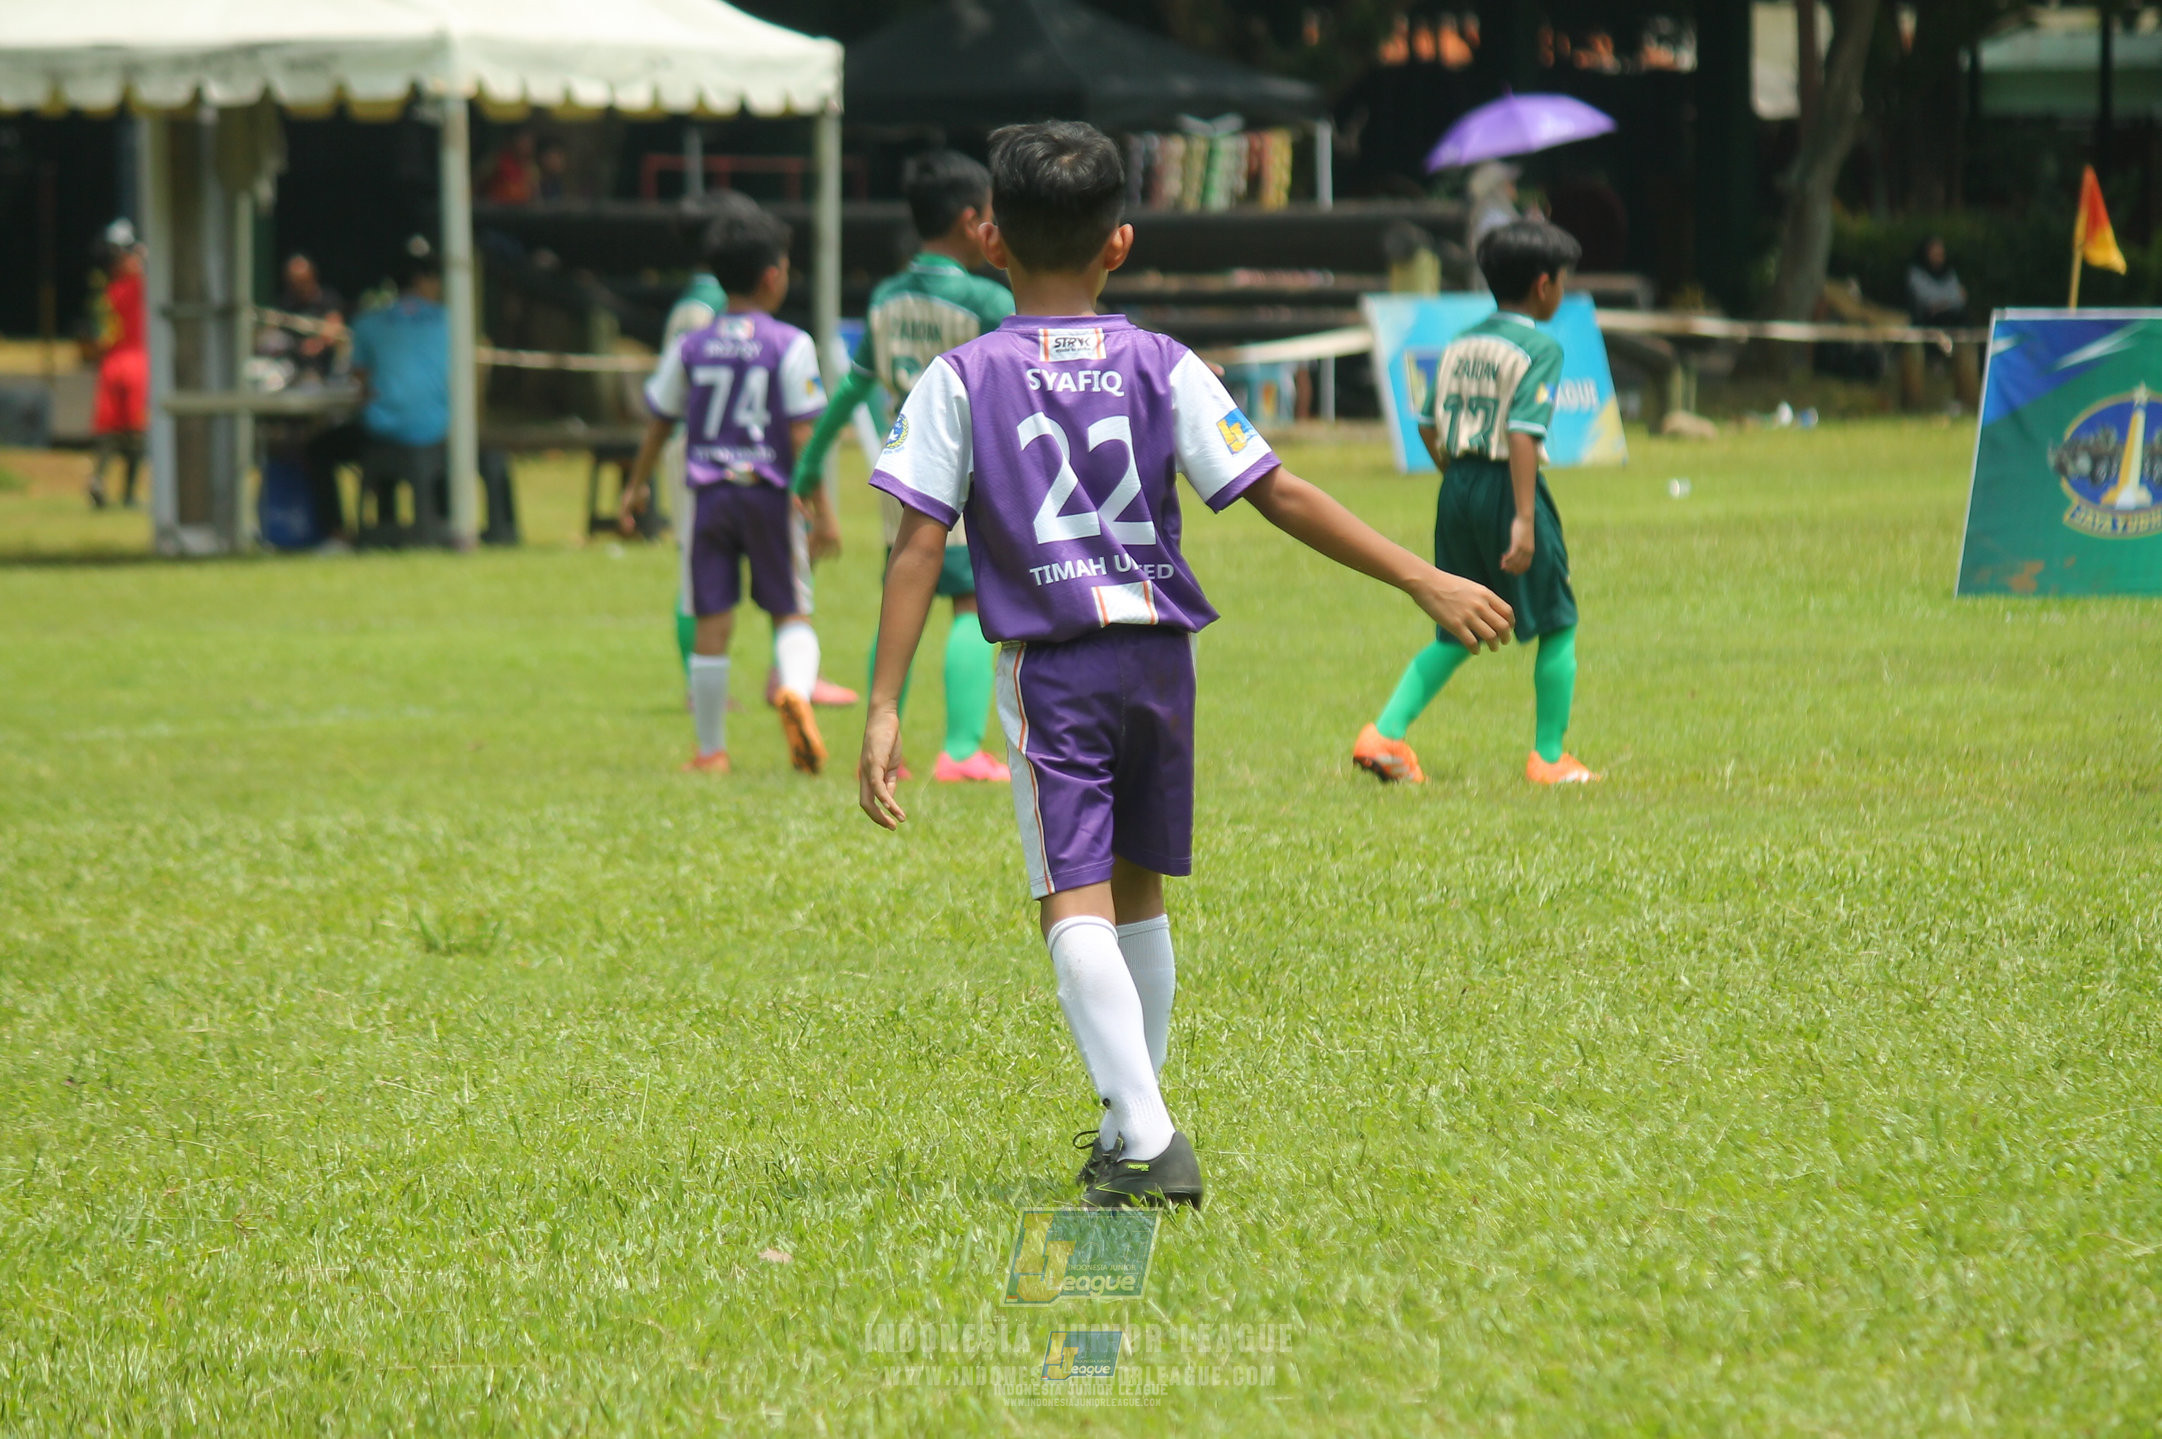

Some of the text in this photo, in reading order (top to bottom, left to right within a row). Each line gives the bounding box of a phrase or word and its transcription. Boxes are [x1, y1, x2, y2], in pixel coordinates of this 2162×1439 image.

[692, 366, 772, 441] 74
[1026, 368, 1124, 397] SYAFIQ
[1016, 411, 1156, 545] 22
[1029, 553, 1175, 586] TIMAH UED
